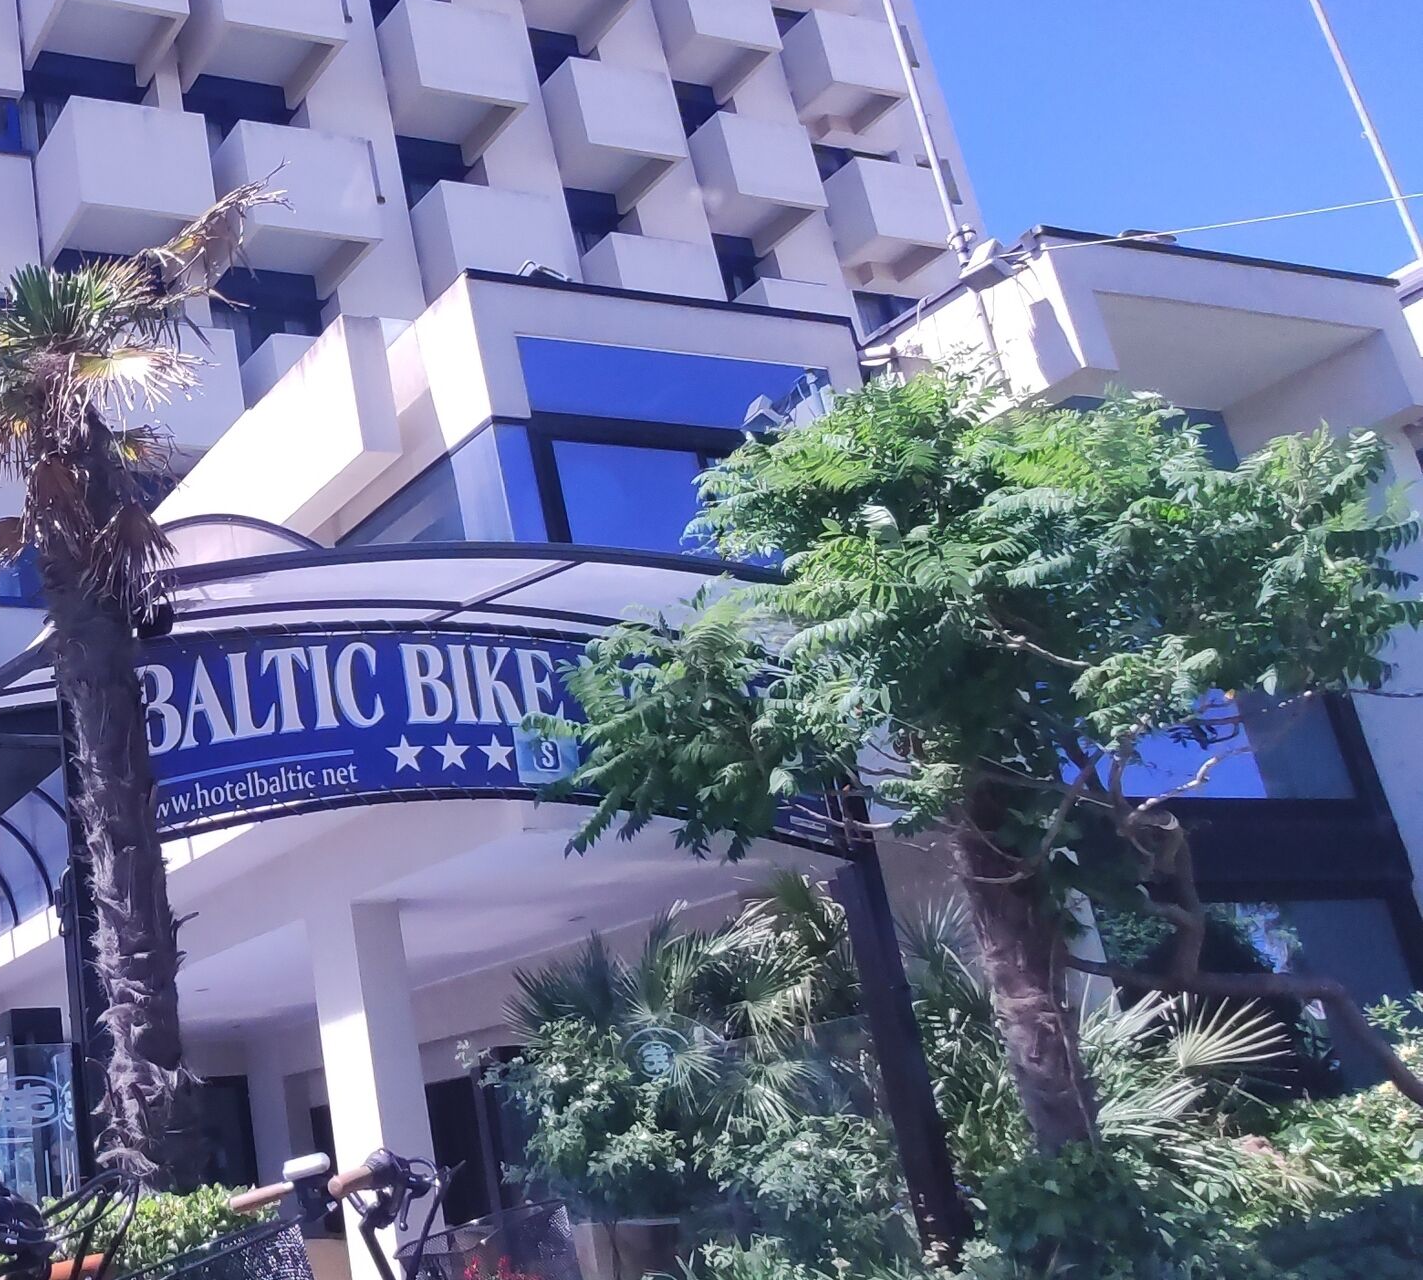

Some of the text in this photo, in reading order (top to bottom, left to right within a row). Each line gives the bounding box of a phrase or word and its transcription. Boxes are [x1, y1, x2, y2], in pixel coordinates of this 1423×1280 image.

[134, 641, 385, 757] BALTIC
[398, 642, 566, 727] BIKE
[156, 762, 359, 820] ww.hotelbaltic.net
